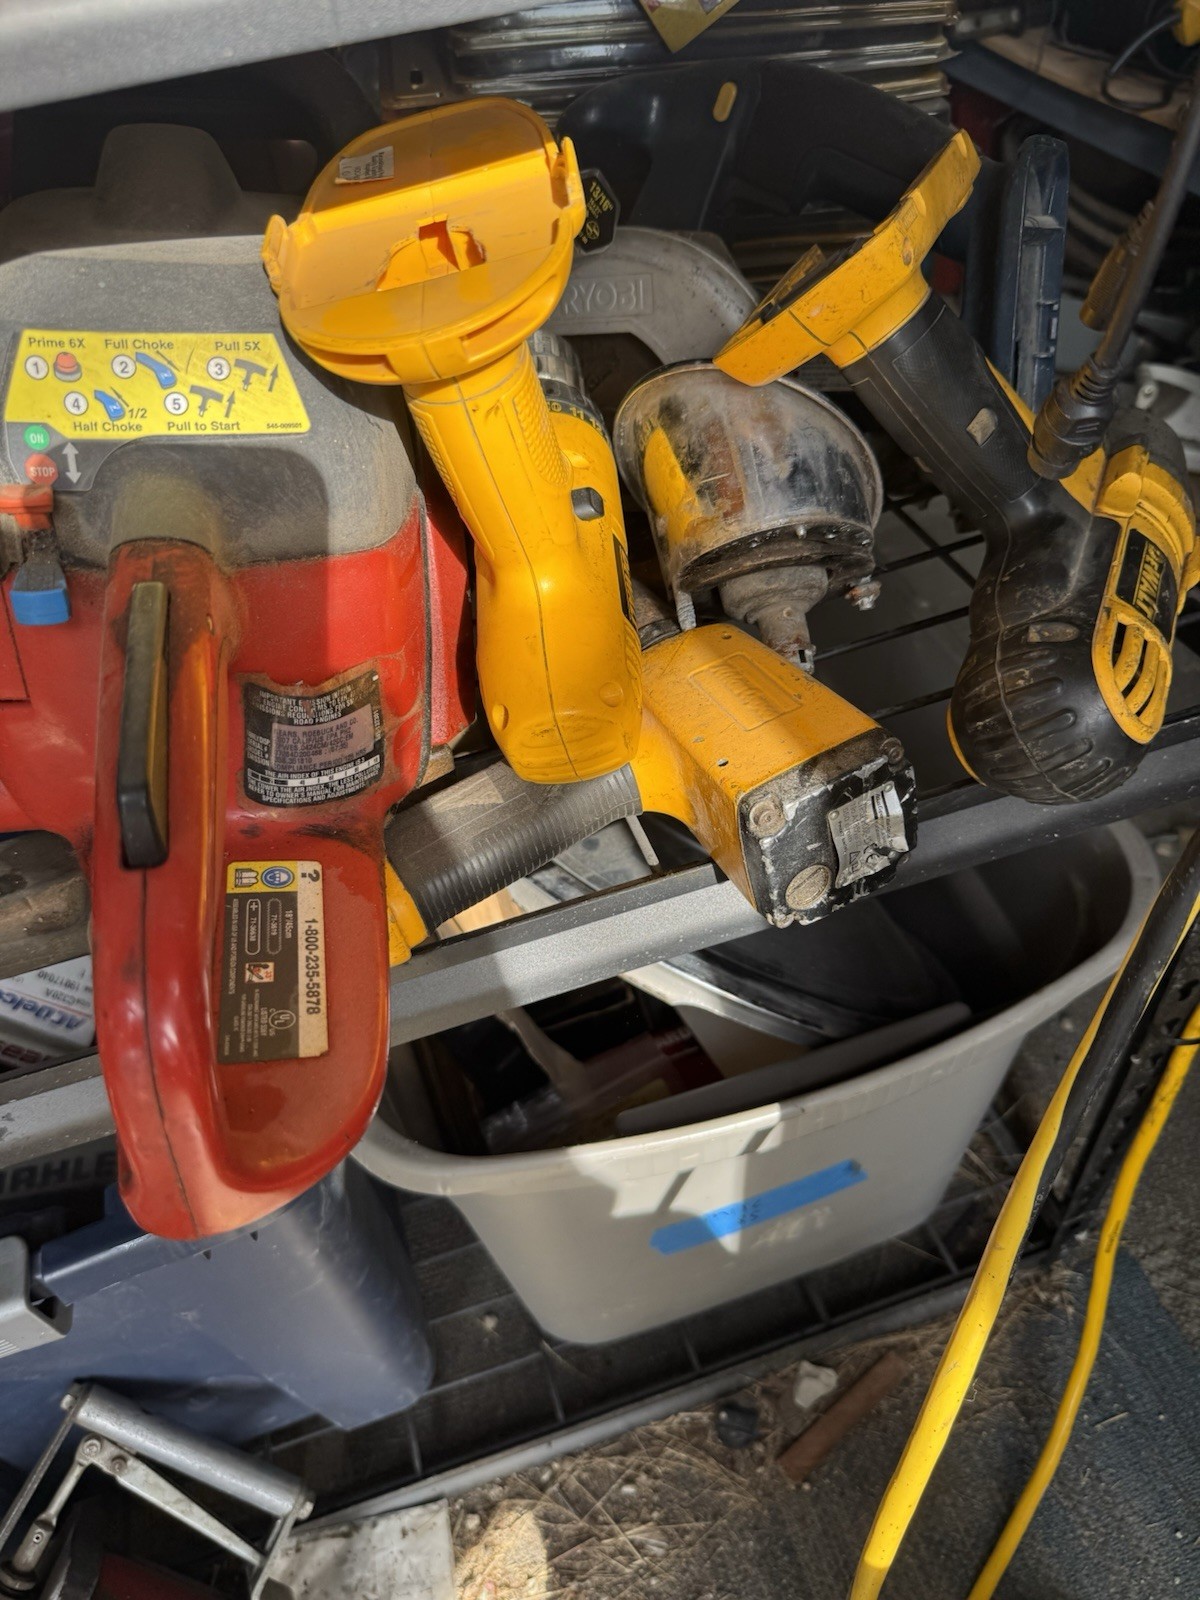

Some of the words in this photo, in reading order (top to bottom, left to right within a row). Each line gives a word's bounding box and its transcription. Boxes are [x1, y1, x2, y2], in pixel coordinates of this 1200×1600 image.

[564, 279, 645, 315] RYOBI
[28, 337, 65, 348] Prime
[69, 338, 86, 348] 6X
[104, 339, 129, 349] Full
[132, 339, 174, 350] Choke
[215, 341, 240, 351] Pull
[244, 341, 261, 351] 5X
[119, 361, 129, 374] 2
[215, 363, 224, 376] 3
[172, 398, 181, 411] 5
[128, 408, 147, 419] 1/2
[73, 421, 98, 432] Half
[102, 421, 143, 432] Choke
[167, 421, 191, 431] Pull
[195, 421, 207, 431] to
[211, 420, 241, 431] Start
[29, 433, 45, 444] ON
[30, 466, 56, 477] STOP
[293, 718, 314, 726] ROAD
[315, 712, 342, 724] ENGINES
[290, 772, 310, 780] INDEX
[320, 767, 335, 777] THIS
[304, 918, 321, 1015] 1-800-235-5878
[273, 1013, 291, 1025] UL
[0, 1151, 117, 1194] AHLE
